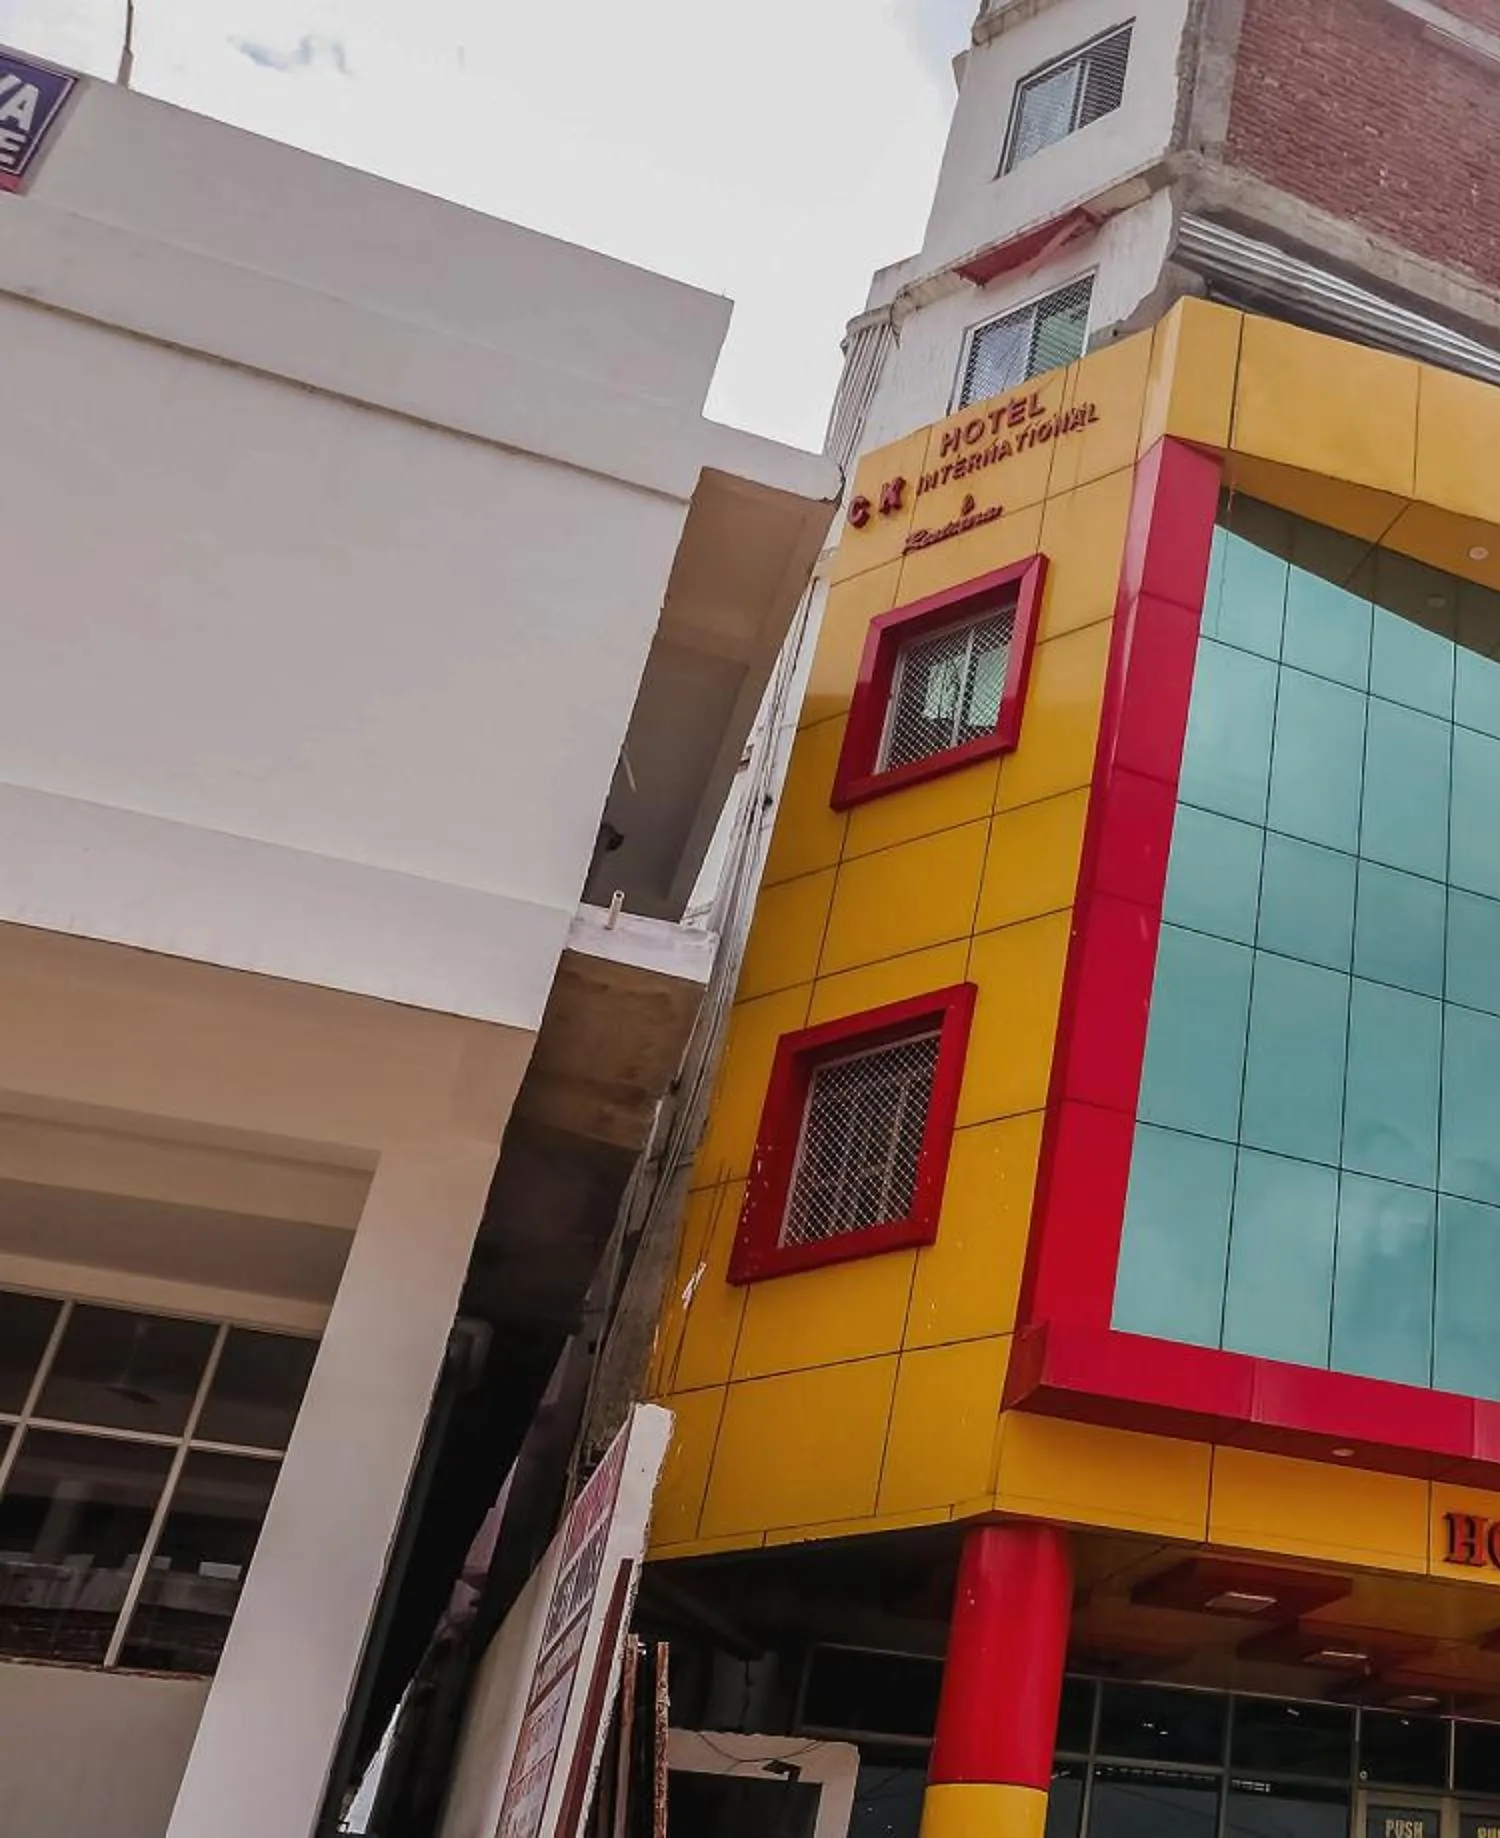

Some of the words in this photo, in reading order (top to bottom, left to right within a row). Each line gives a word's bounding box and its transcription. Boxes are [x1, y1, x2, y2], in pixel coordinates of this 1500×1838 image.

[916, 402, 1100, 496] INTERNATIONAL
[940, 393, 1046, 458] HOTEL
[1385, 1819, 1423, 1838] PUSH
